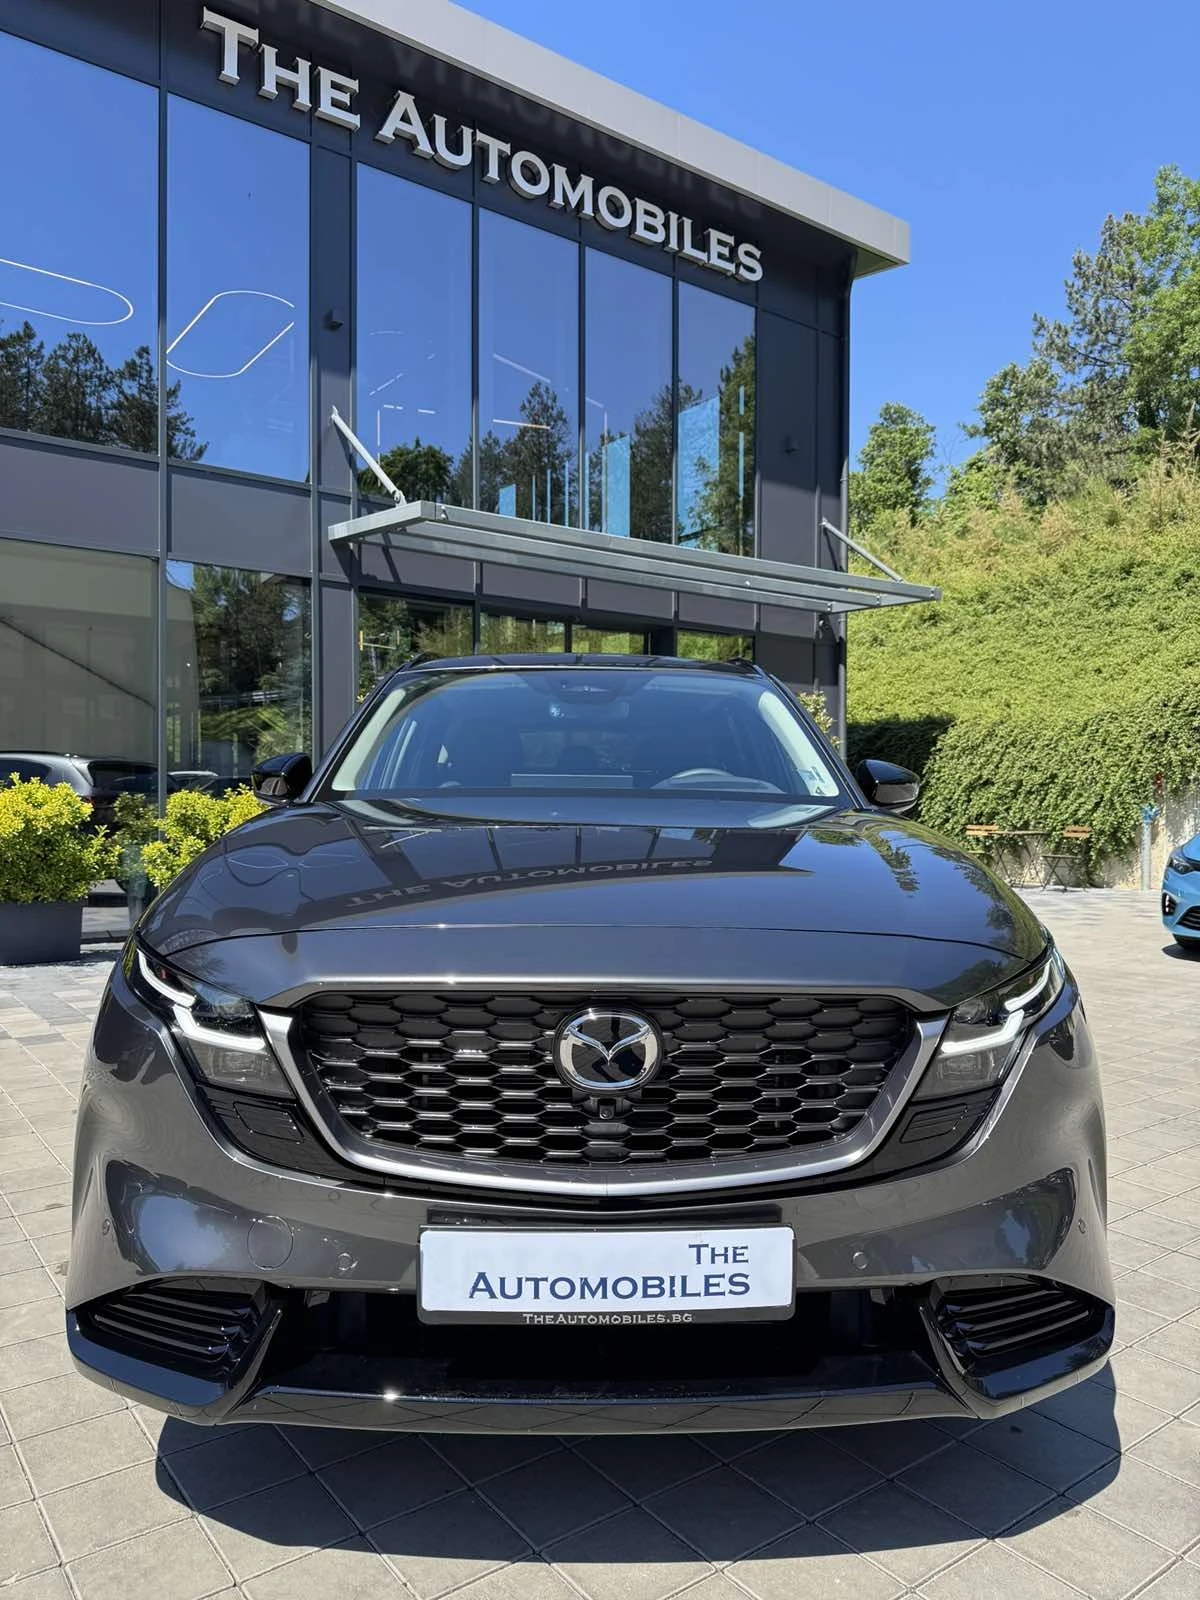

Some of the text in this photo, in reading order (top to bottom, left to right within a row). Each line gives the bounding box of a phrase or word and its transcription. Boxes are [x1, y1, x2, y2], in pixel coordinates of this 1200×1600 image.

[202, 7, 361, 132] THE
[375, 90, 763, 283] AUTOMOBILES
[688, 1243, 749, 1265] THE
[468, 1271, 751, 1300] AUTOMOBILES
